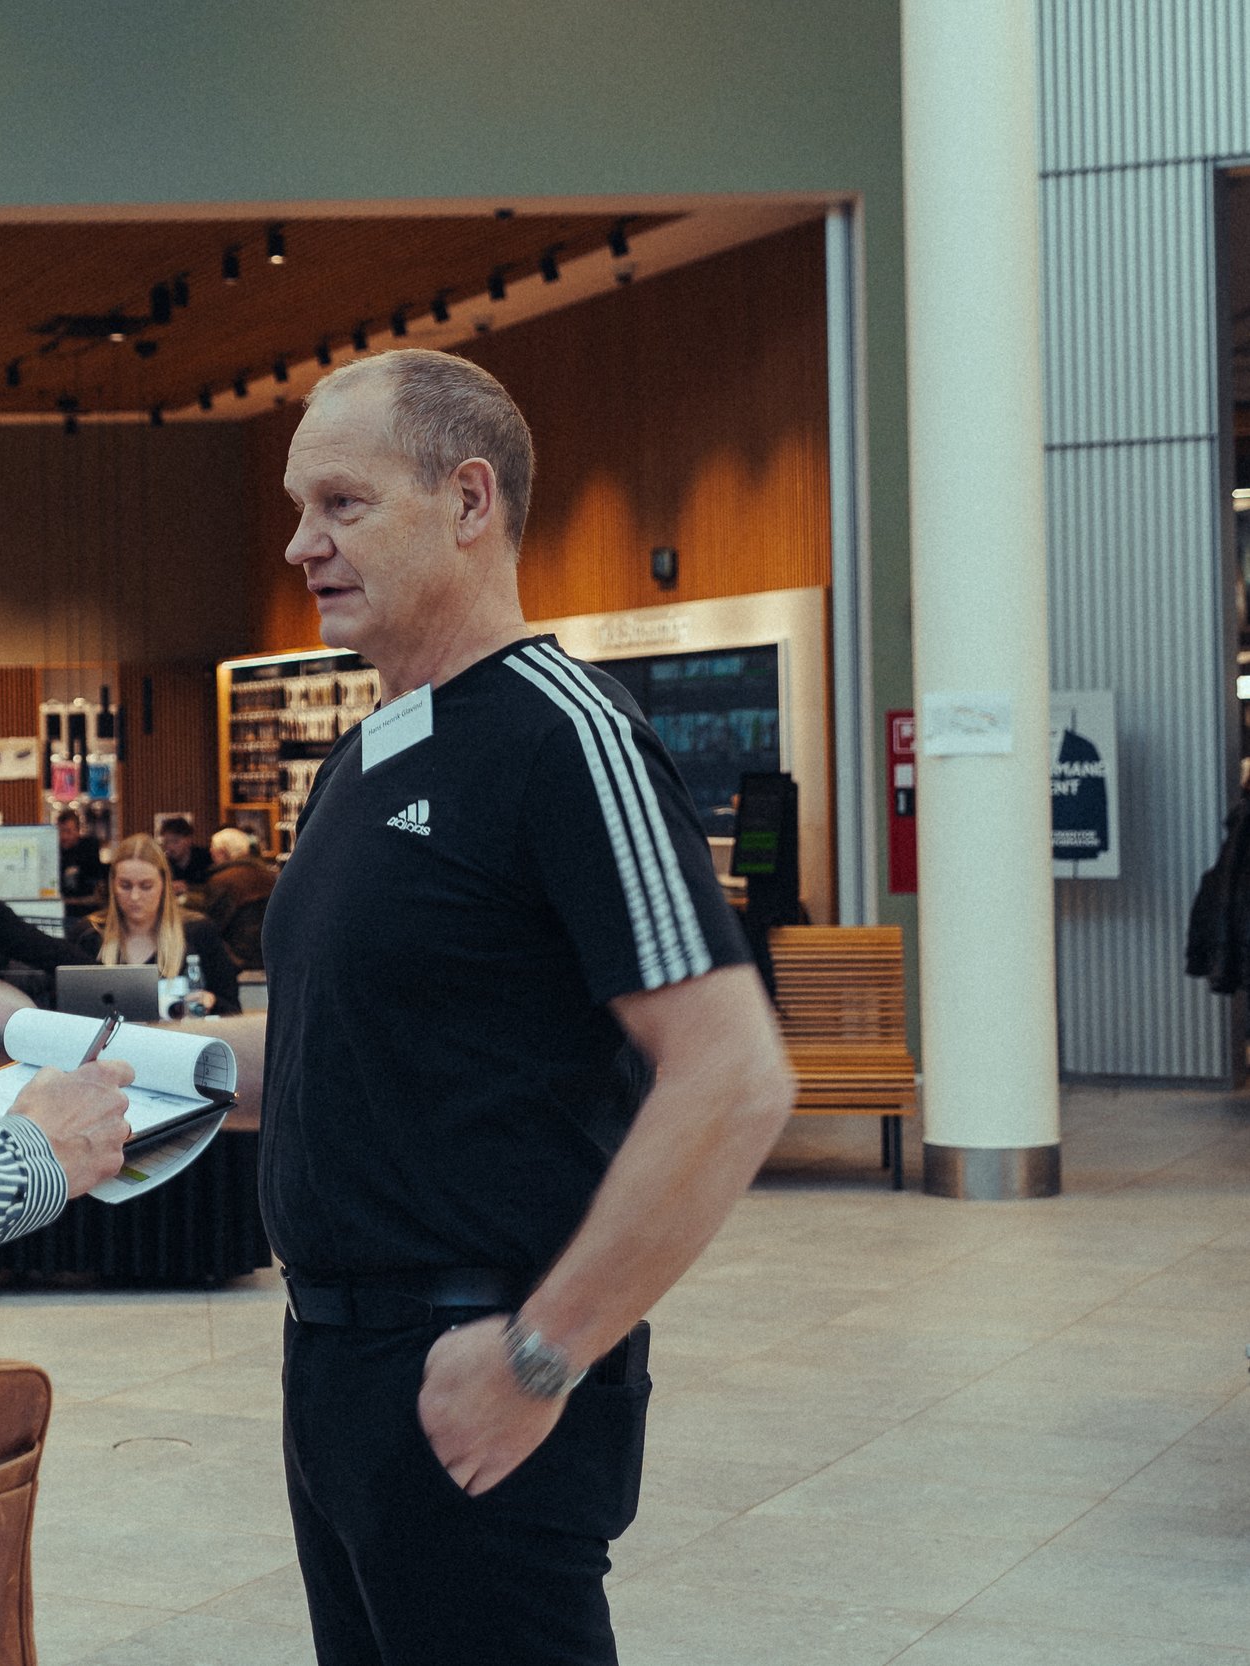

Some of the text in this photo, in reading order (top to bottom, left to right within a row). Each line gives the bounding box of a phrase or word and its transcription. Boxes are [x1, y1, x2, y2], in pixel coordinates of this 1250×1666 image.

[368, 699, 424, 737] Hans Henrik Glavind
[386, 816, 431, 836] adidas
